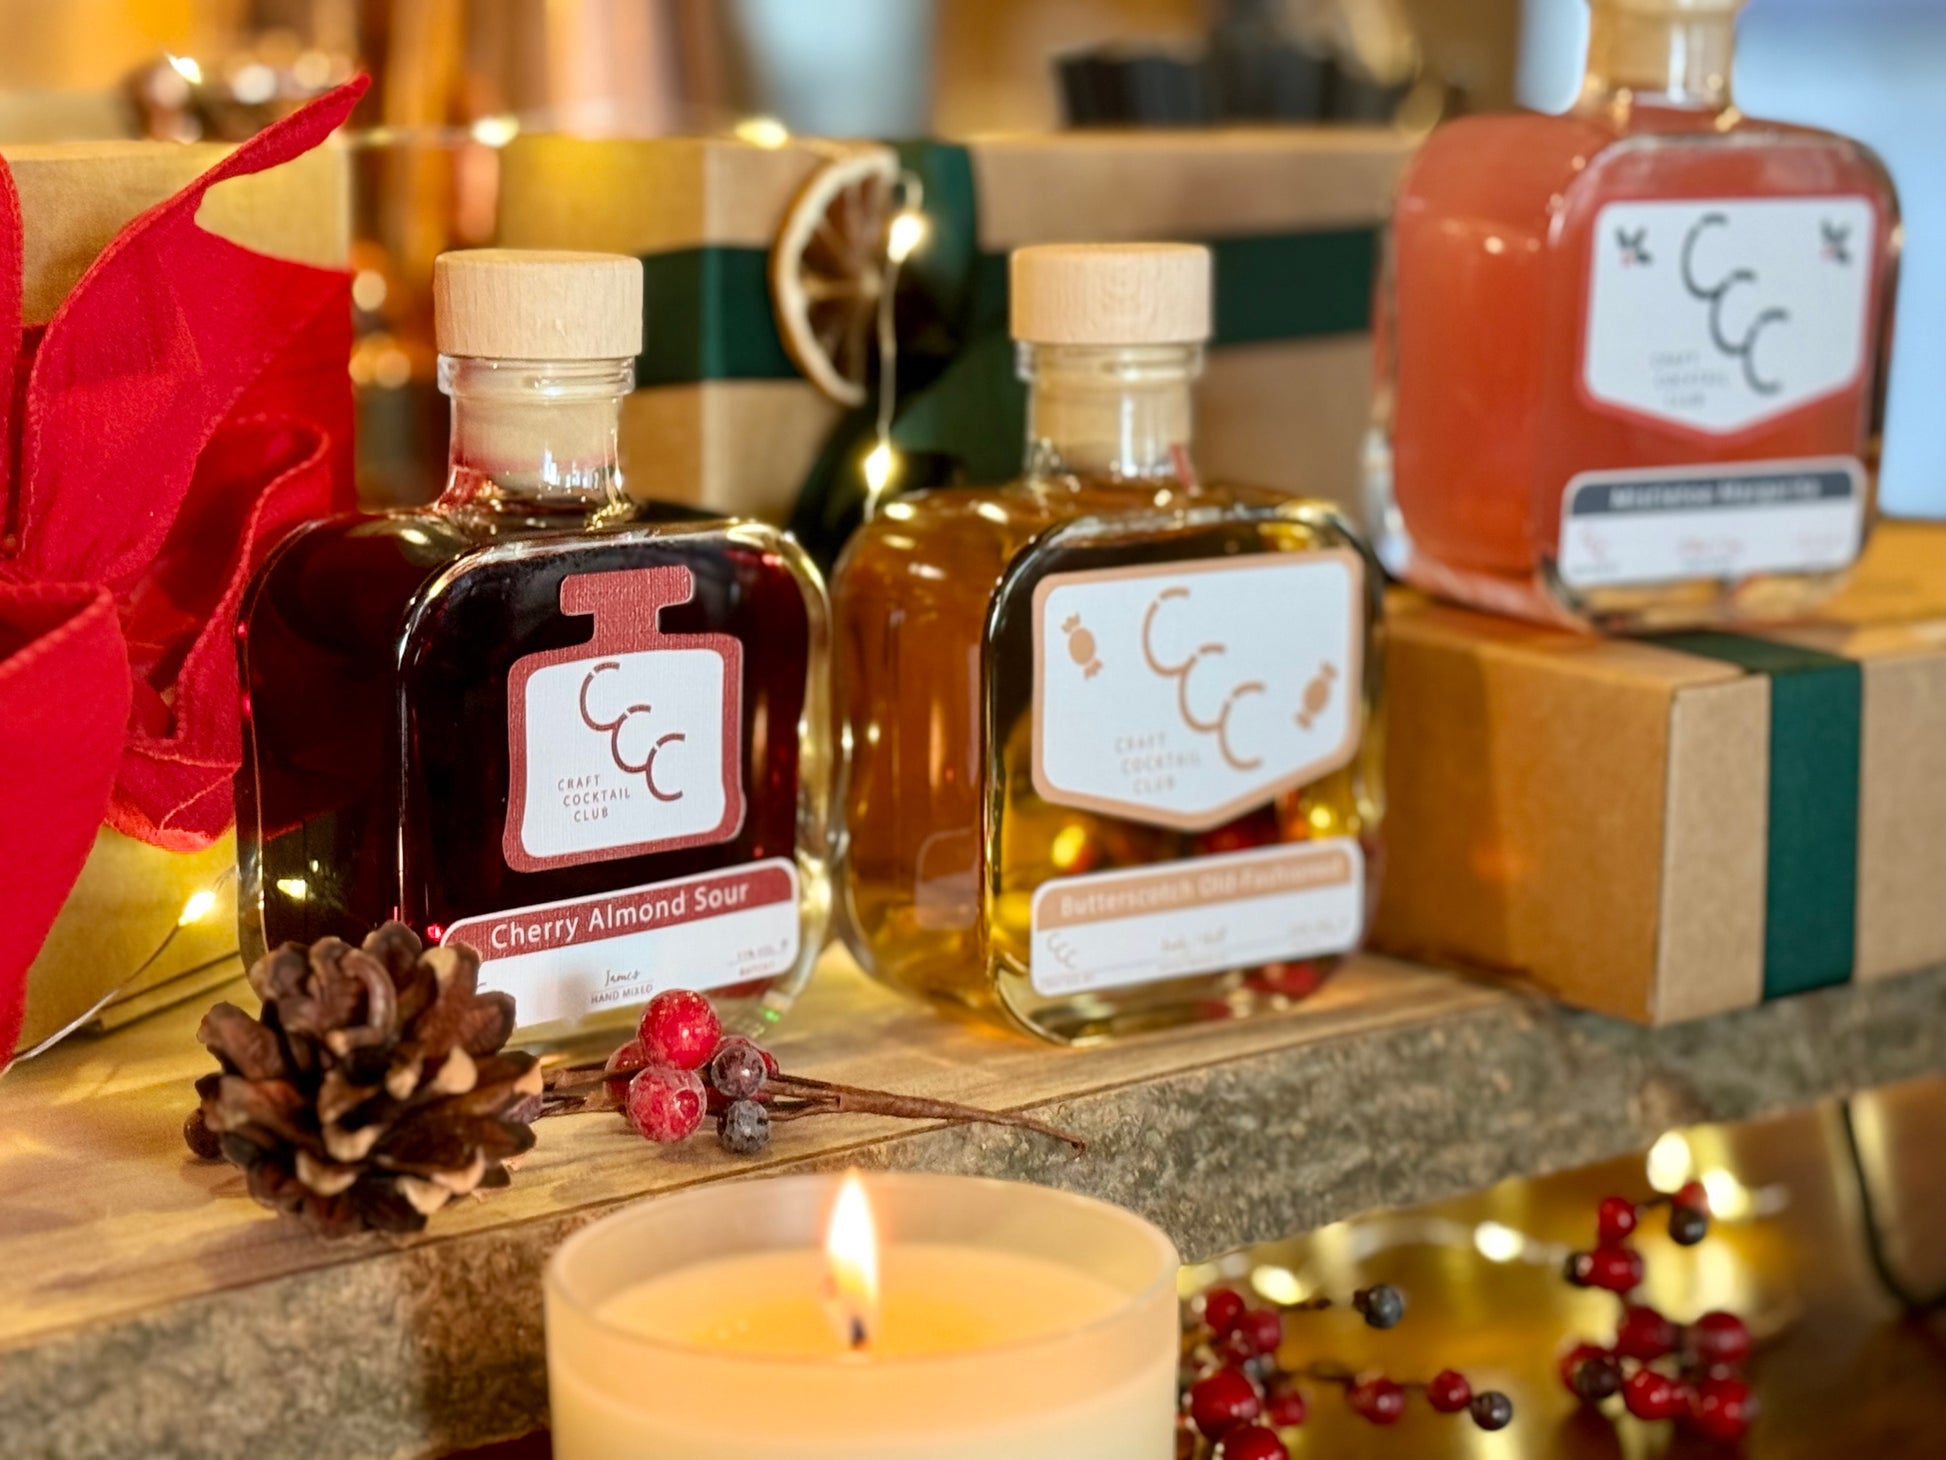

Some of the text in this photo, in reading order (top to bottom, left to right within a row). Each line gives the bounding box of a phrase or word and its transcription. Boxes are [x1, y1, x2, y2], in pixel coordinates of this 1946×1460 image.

[1114, 731, 1166, 754] CRAFT
[1120, 751, 1202, 776] COCKTAIL
[557, 774, 600, 792] CRAFT
[1132, 774, 1177, 795] CLUB
[563, 787, 631, 807] COCKTAIL
[573, 806, 609, 823] CLUB
[490, 882, 749, 950] Cherry Almond Sour
[590, 983, 654, 1006] HAND MIXED
